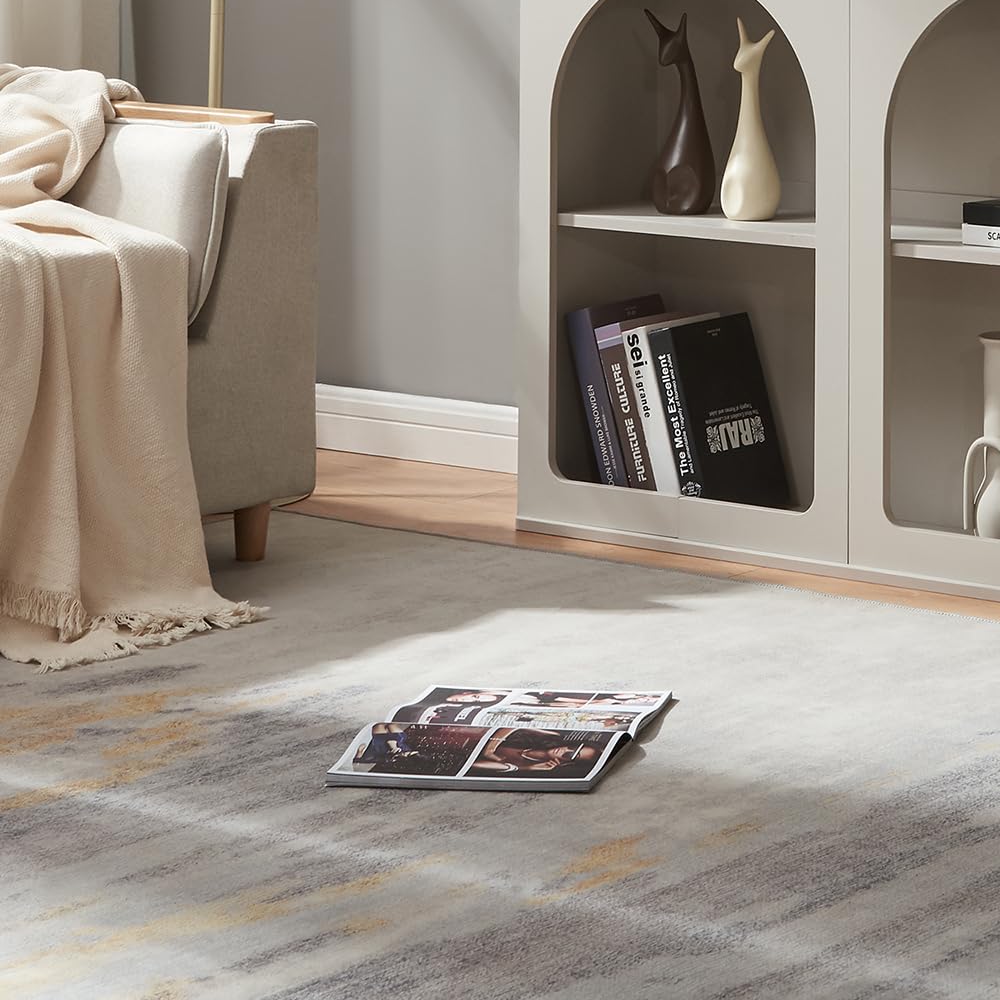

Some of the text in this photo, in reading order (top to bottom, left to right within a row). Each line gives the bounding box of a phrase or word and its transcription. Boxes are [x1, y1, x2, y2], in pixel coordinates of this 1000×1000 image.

[635, 370, 644, 380] si
[587, 384, 603, 428] SNOWDEN
[635, 382, 651, 419] grande
[658, 354, 691, 477] The Most Excellent
[611, 362, 647, 482] FURNITURE CULTURE
[718, 417, 755, 451] RAJ
[597, 428, 613, 466] EDWARD
